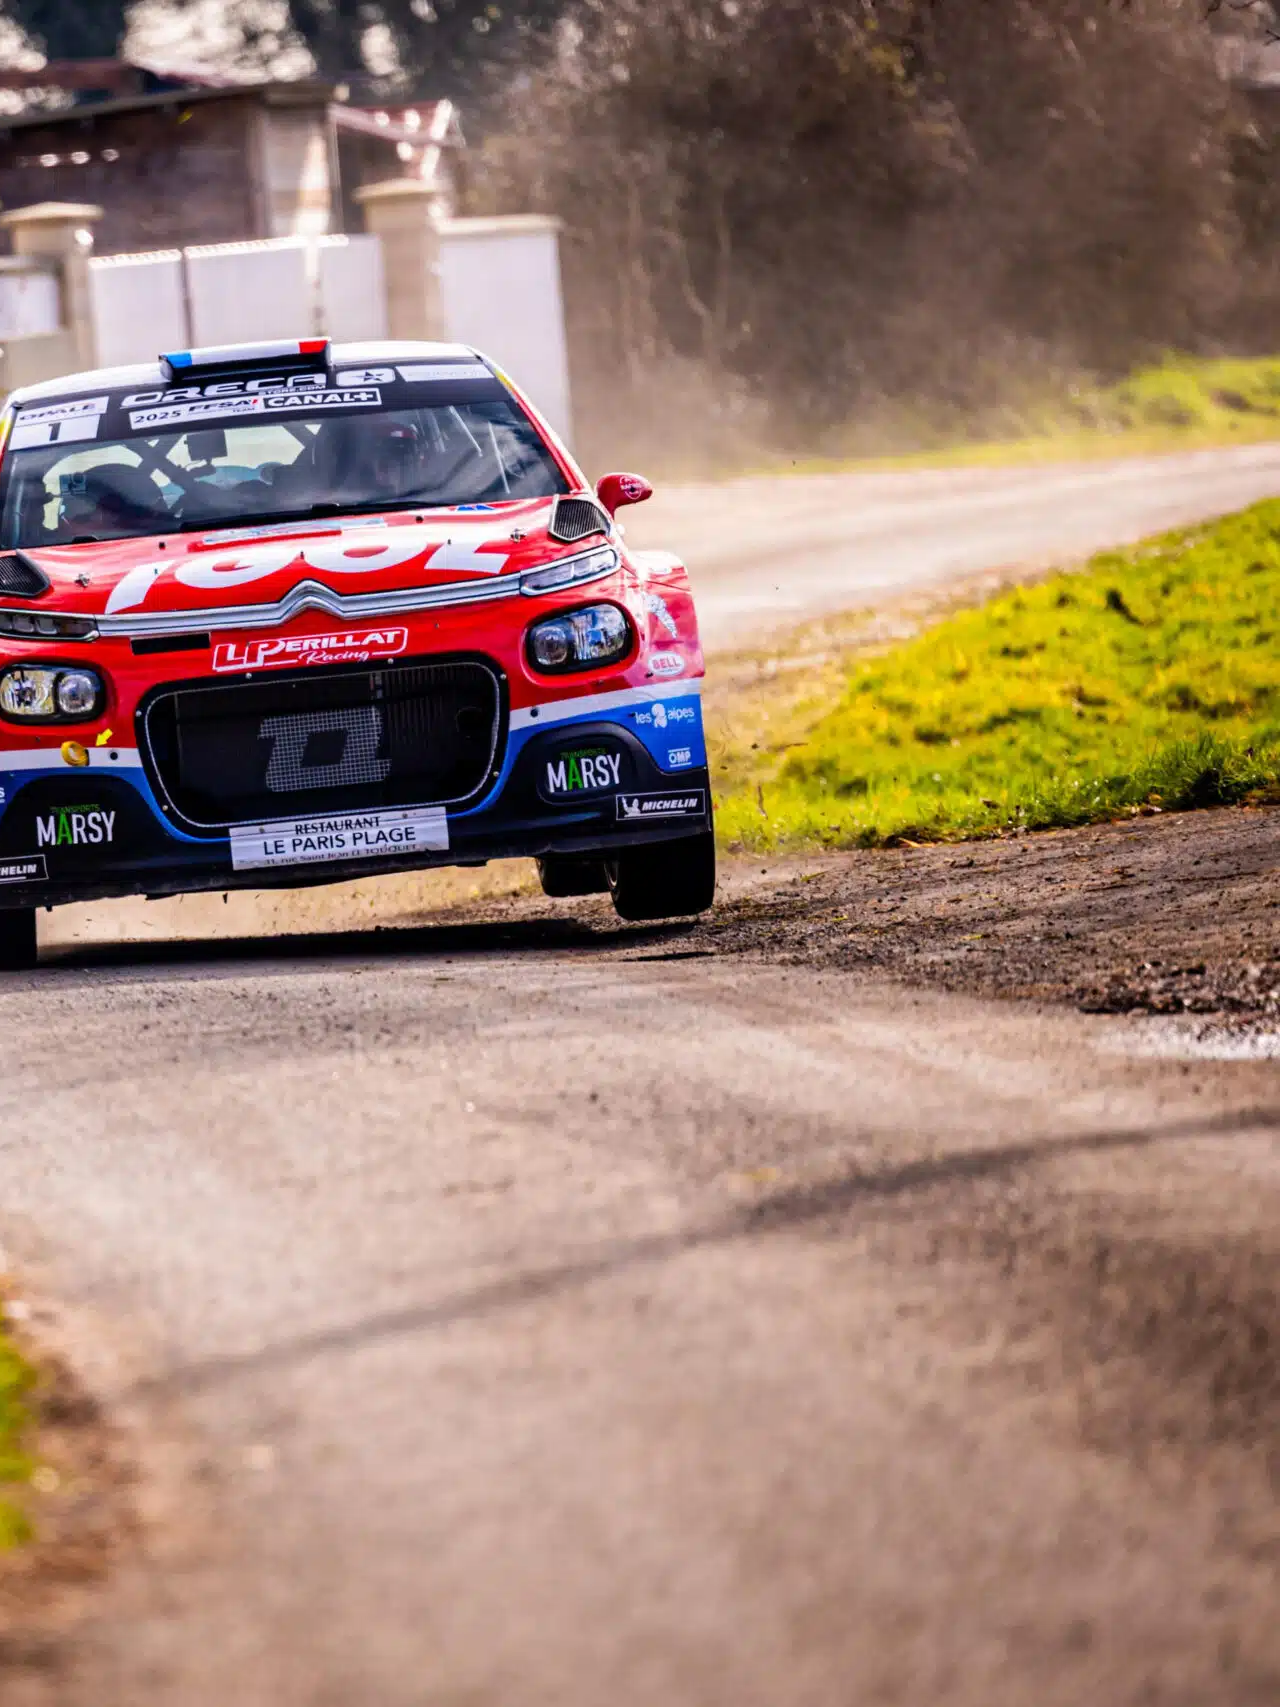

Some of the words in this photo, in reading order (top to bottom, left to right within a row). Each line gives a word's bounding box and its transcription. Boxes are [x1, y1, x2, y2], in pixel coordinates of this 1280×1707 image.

[120, 373, 327, 407] ORECA
[268, 390, 373, 407] CANAL+
[133, 411, 181, 424] 2025
[48, 422, 62, 442] 1
[298, 651, 370, 665] Racing
[652, 656, 682, 670] BELL
[635, 711, 651, 724] les
[668, 706, 695, 720] alpes
[669, 751, 691, 763] OMP
[547, 753, 620, 793] MARSY
[642, 798, 698, 812] MICHELIN
[36, 811, 116, 847] MARSY
[295, 816, 381, 835] RESTAURANT
[263, 839, 286, 856] LE
[292, 834, 346, 852] PARIS
[352, 827, 417, 847] PLAGE
